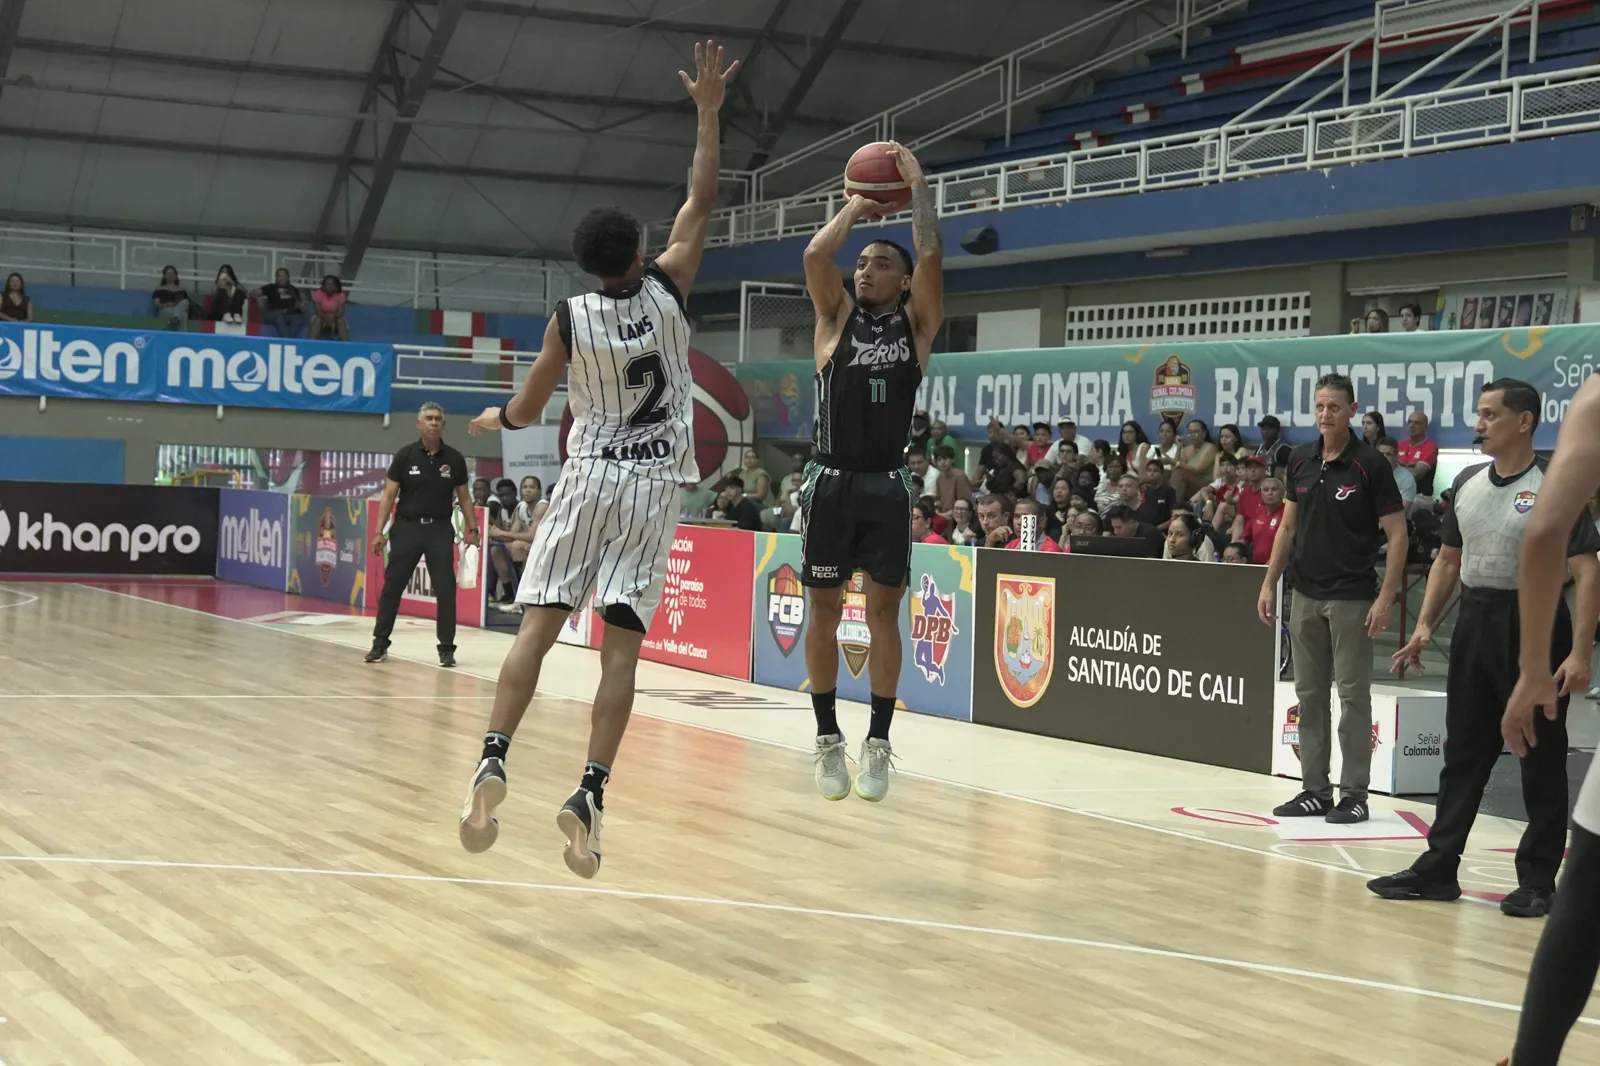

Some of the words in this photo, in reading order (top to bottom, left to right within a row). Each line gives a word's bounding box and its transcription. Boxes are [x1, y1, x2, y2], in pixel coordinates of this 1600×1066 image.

[617, 315, 654, 342] LANS
[167, 343, 376, 397] molten
[1553, 354, 1600, 388] Señ
[622, 350, 670, 427] 2
[975, 370, 1134, 427] COLOMBIA
[1213, 360, 1494, 428] BALOCESTO
[18, 511, 201, 561] khanpro
[221, 508, 282, 568] molten
[1022, 516, 1028, 529] 3
[1022, 530, 1028, 543] 2
[671, 536, 693, 552] ACIÓN
[689, 594, 707, 609] todos
[768, 594, 805, 625] FCB
[911, 614, 951, 643] DPB
[1069, 625, 1138, 653] ALCALDÍA
[1143, 633, 1162, 656] DE
[663, 638, 677, 653] Valle
[678, 641, 688, 655] del
[688, 643, 708, 659] Cauca
[1068, 656, 1161, 693] SANTIAGO
[1167, 668, 1193, 698] DE
[1199, 672, 1244, 705] CALI
[1403, 745, 1440, 757] Colombia
[1418, 733, 1440, 745] Señal
